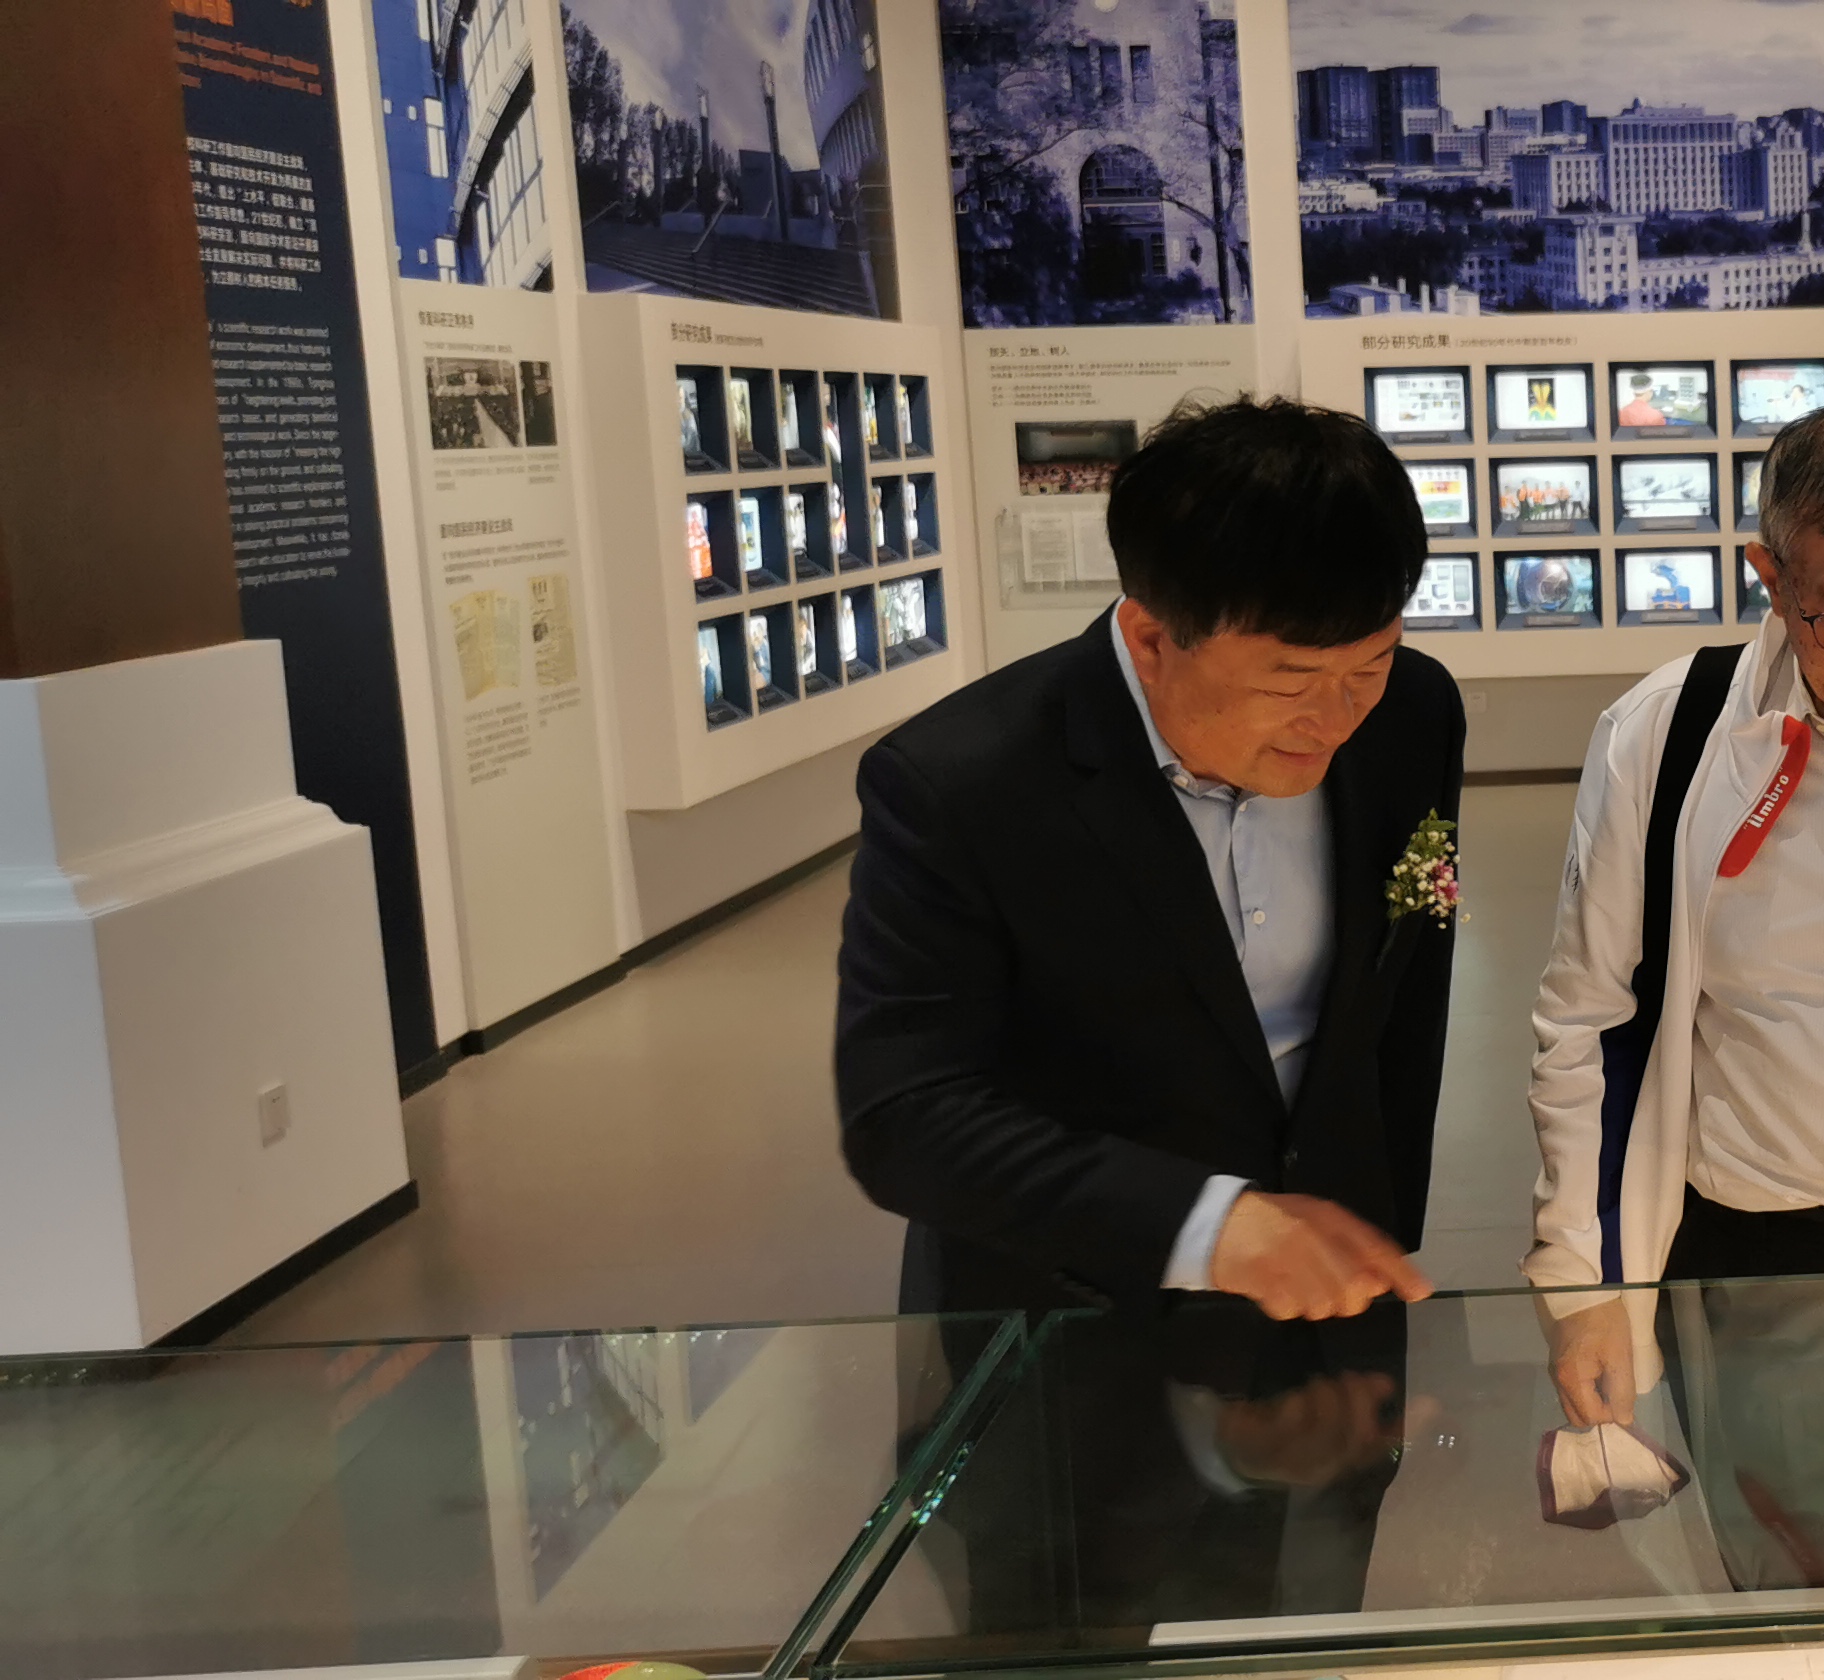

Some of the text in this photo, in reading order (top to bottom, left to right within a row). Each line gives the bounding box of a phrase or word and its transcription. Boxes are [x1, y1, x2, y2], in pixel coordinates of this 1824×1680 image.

[1362, 335, 1449, 349] 部分研究成果
